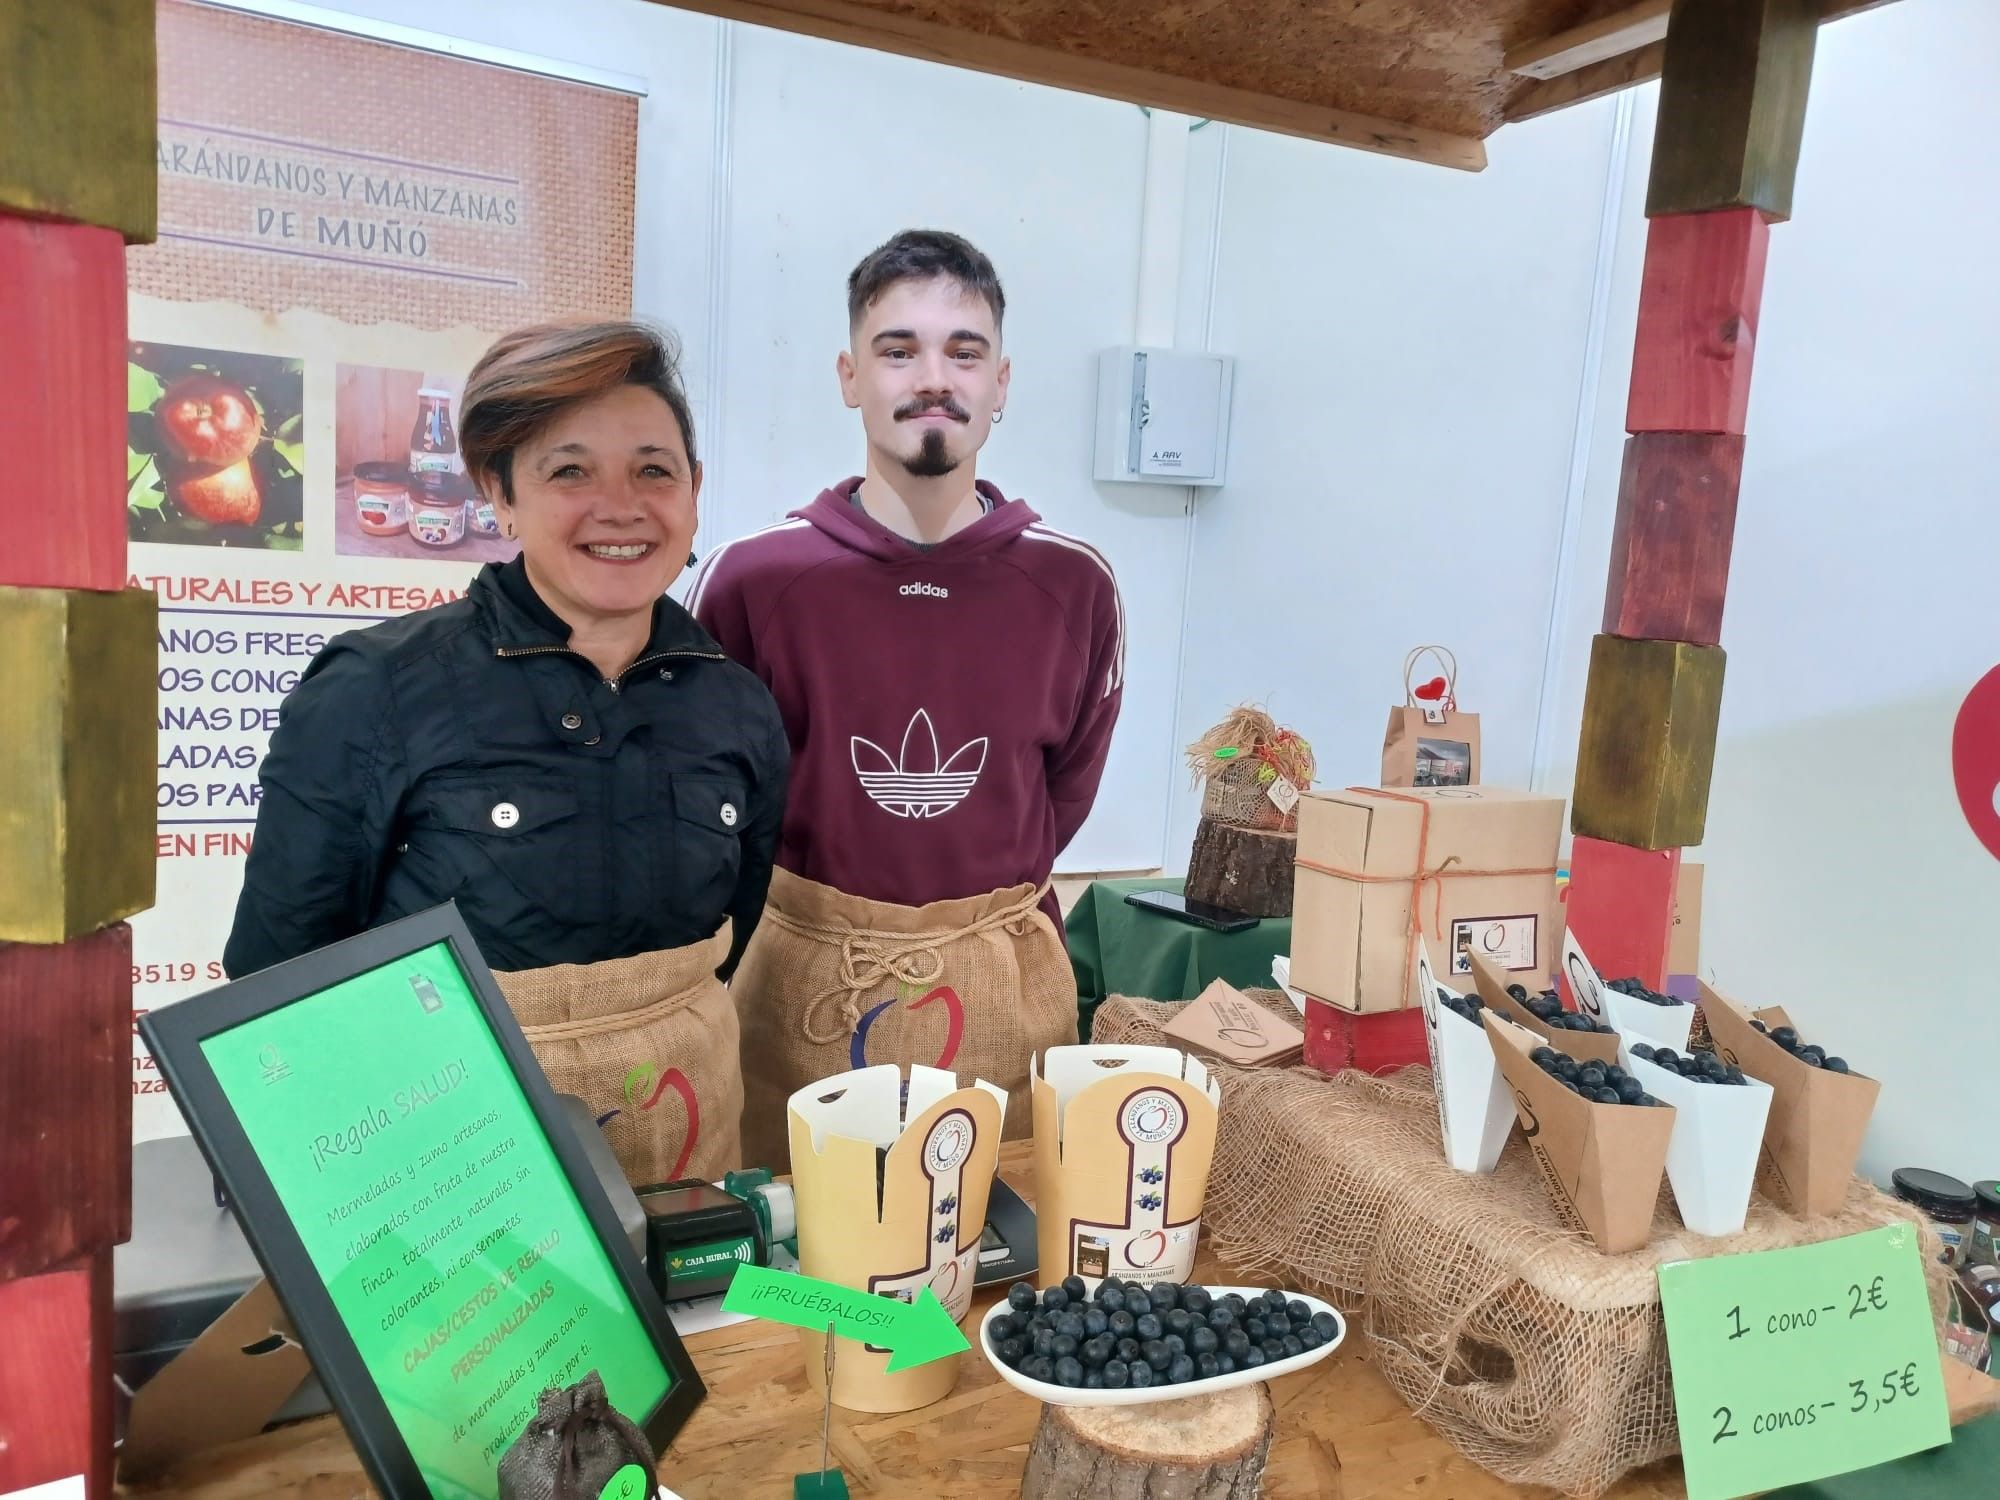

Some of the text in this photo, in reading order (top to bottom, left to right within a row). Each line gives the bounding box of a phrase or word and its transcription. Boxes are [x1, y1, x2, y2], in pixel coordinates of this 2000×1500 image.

[338, 171, 354, 200] Y
[364, 176, 517, 226] MANZANAS
[257, 207, 427, 257] DE MUÑÓ
[300, 582, 321, 606] Y
[899, 582, 948, 598] adidas
[246, 632, 326, 656] FRES
[210, 669, 304, 693] CONG
[240, 708, 280, 731] DE
[156, 833, 196, 857] EN
[207, 961, 228, 980] S
[309, 1058, 470, 1173] ¡Regala SALUD!
[327, 1109, 502, 1228] Mermeladas y zumo artesanos,
[345, 1136, 516, 1261] elaborados con fruta de nuestra
[361, 1165, 531, 1298] finca, totalmente naturales sin
[685, 1251, 733, 1267] CAJA RURAL
[381, 1212, 523, 1331] colorantes, ni conservantes.
[404, 1228, 560, 1374] CAJAS/CESTOS DE REGALO
[451, 1279, 555, 1384] PERSONALIZADAS
[752, 1284, 895, 1328] ¡¡PRUÉBALOS!!
[1726, 1306, 1750, 1340] 1
[1848, 1276, 1888, 1319] 2€
[452, 1303, 589, 1444] de mermeladas y zumo con los
[1712, 1407, 1738, 1444] 2
[1849, 1362, 1920, 1413] 3,5€
[481, 1406, 530, 1467] productos
[565, 1354, 580, 1380] por
